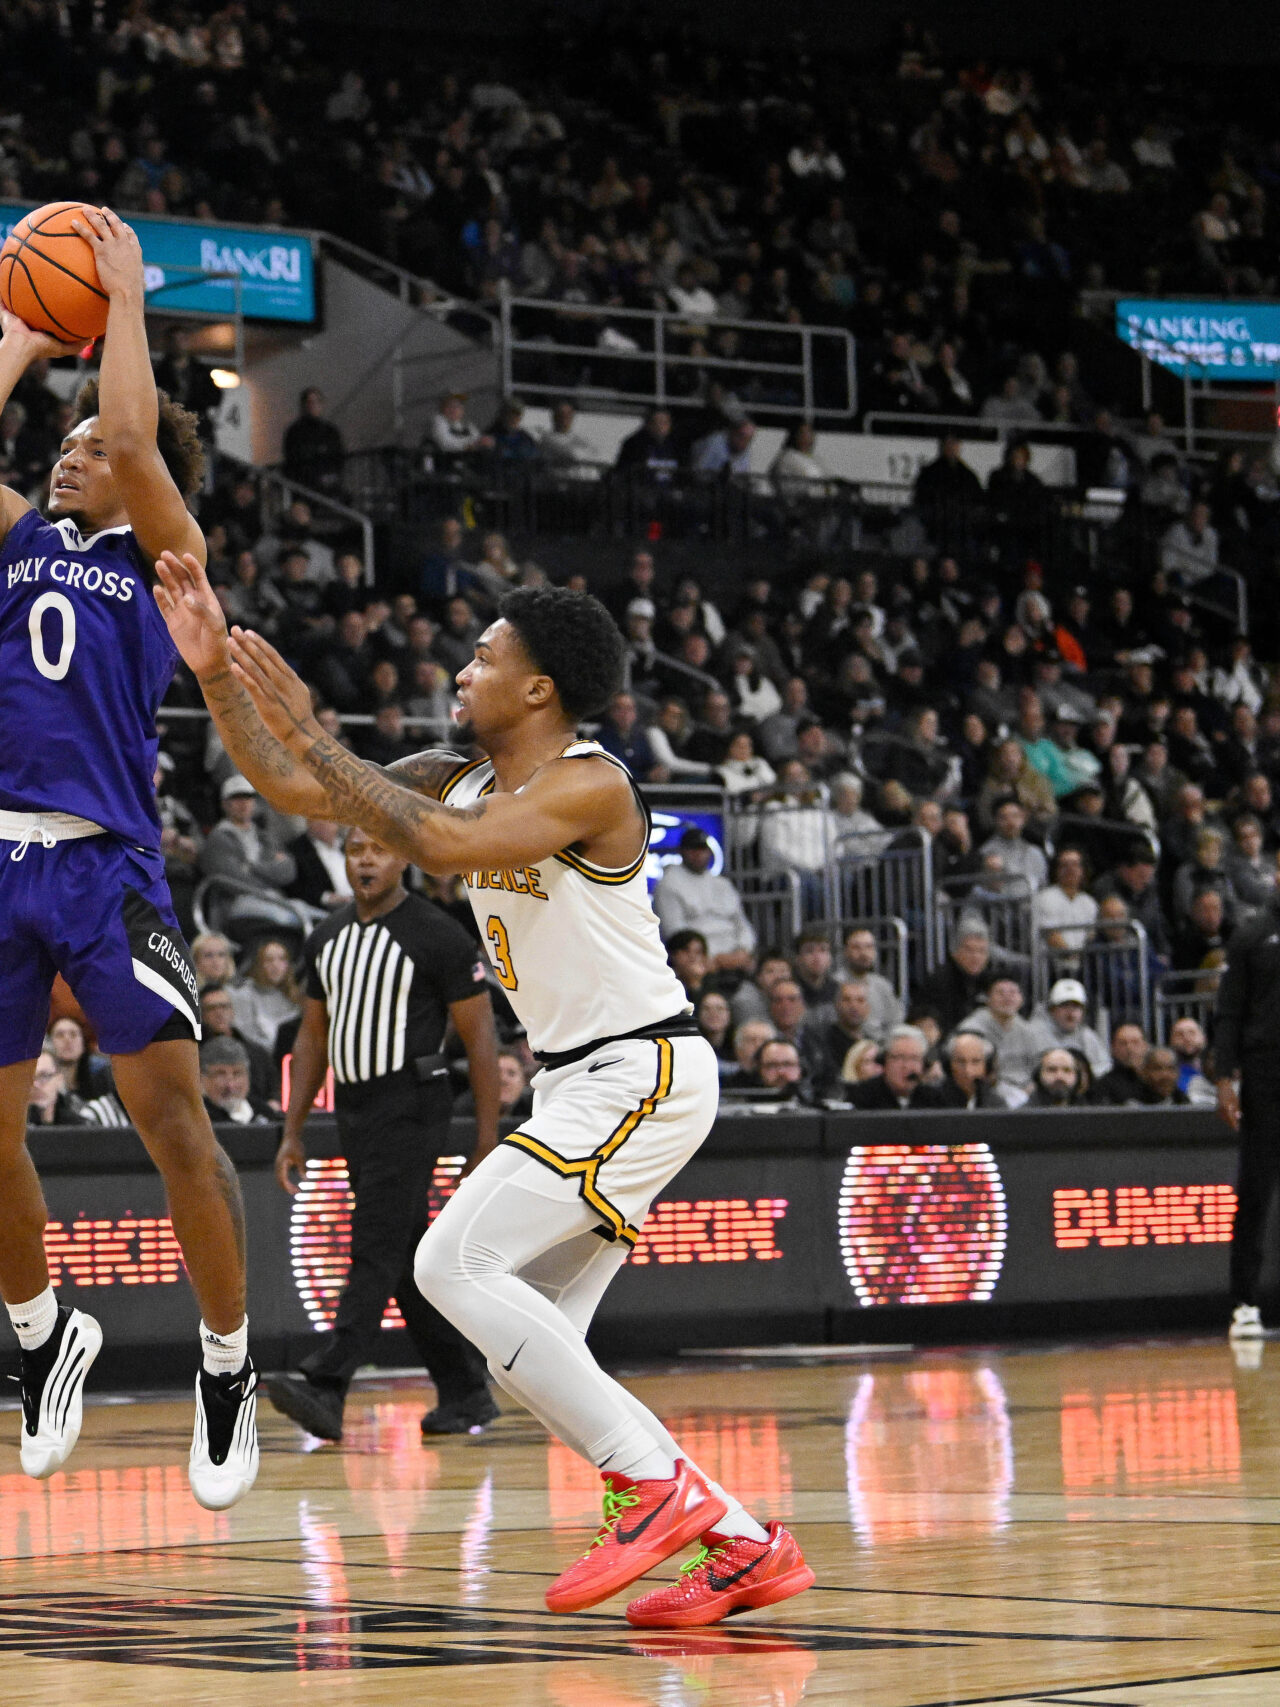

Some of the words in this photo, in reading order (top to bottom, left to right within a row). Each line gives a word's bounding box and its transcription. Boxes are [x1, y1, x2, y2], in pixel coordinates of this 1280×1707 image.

[49, 559, 137, 602] CROSS
[28, 591, 76, 681] 0
[486, 914, 519, 992] 3
